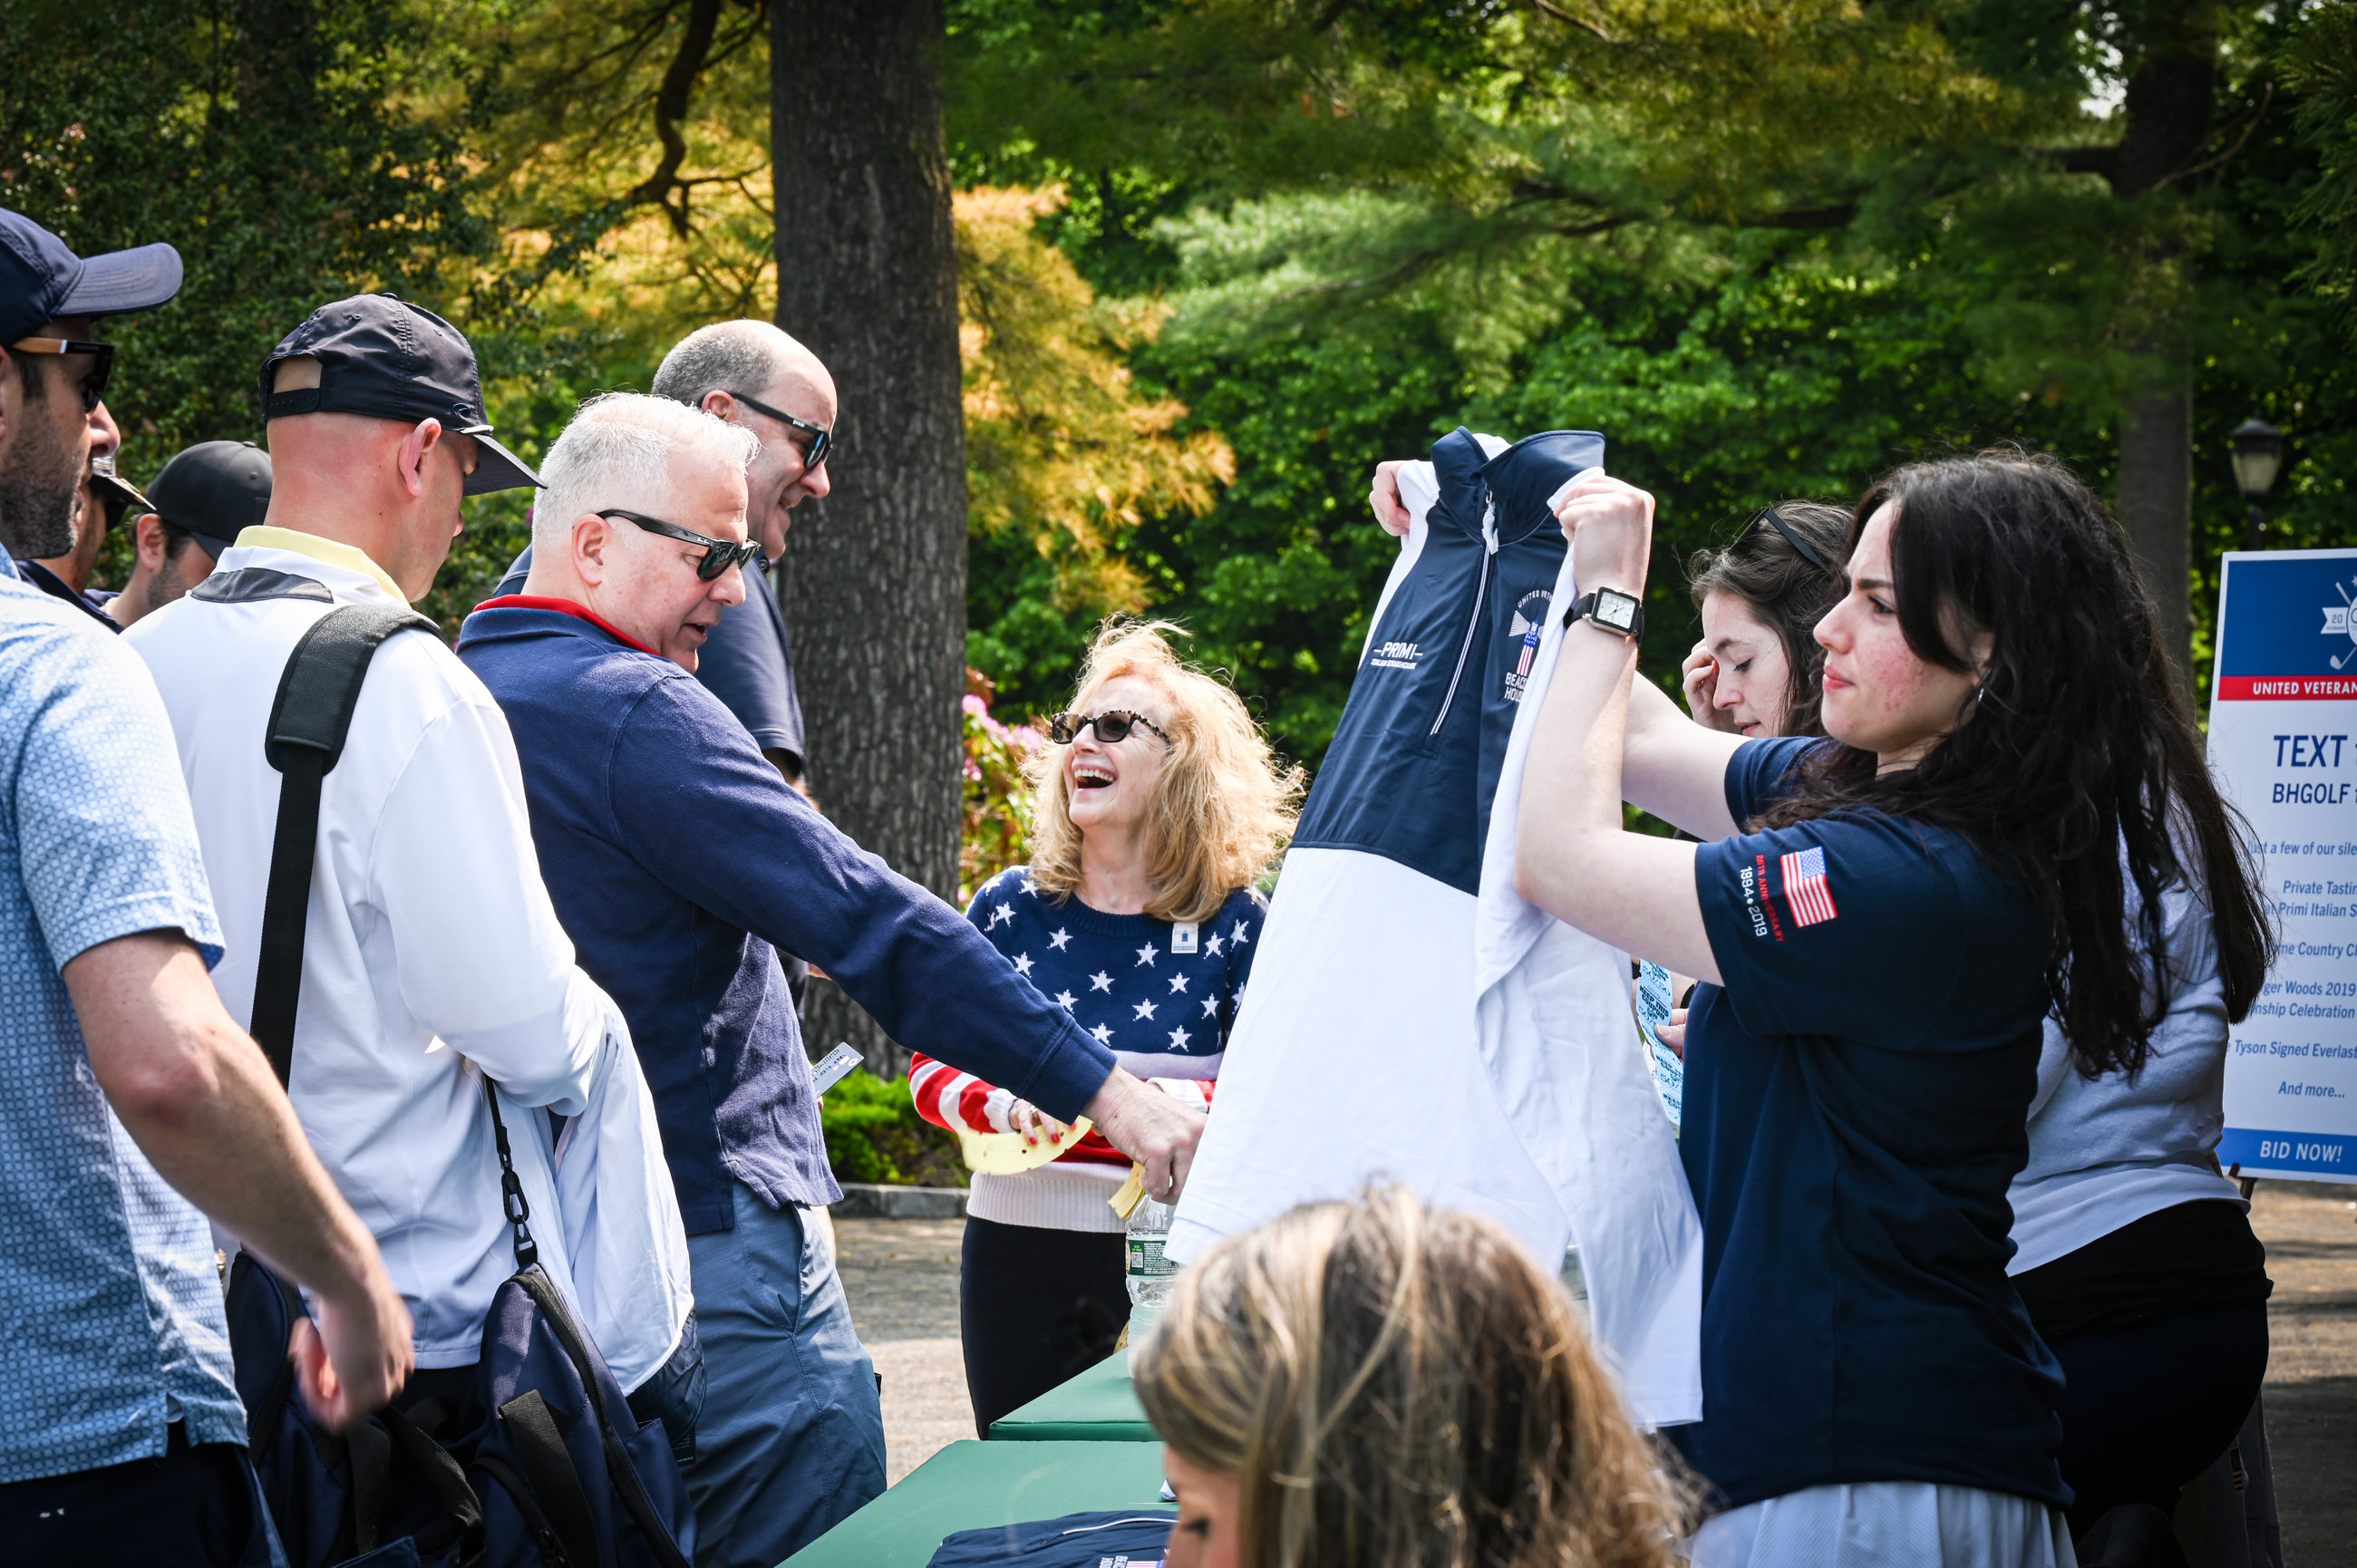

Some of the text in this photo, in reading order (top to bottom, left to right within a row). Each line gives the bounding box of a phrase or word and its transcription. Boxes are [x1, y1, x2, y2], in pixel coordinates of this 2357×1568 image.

[1518, 589, 1540, 608] UNITED
[2253, 682, 2300, 695] UNITED
[2274, 735, 2348, 767] TEXT
[2272, 783, 2351, 804] BHGOLF
[2271, 844, 2277, 855] a
[2280, 841, 2300, 855] few
[2303, 841, 2315, 855] of
[2316, 845, 2335, 856] our
[2283, 880, 2323, 895] Private
[1741, 866, 1768, 937] 1994 2019
[1758, 877, 1785, 943] ANNIVERSARY
[2279, 902, 2309, 916] Primi
[2311, 903, 2346, 917] Italian
[2298, 942, 2343, 959] Country
[2285, 981, 2323, 995] Woods
[2325, 982, 2356, 997] 2019
[2289, 1002, 2355, 1019] Celebration
[2235, 1040, 2266, 1056] Tyson
[2269, 1040, 2309, 1059] Signed
[2278, 1081, 2345, 1099] And more...
[2260, 1140, 2343, 1163] BID NOW!
